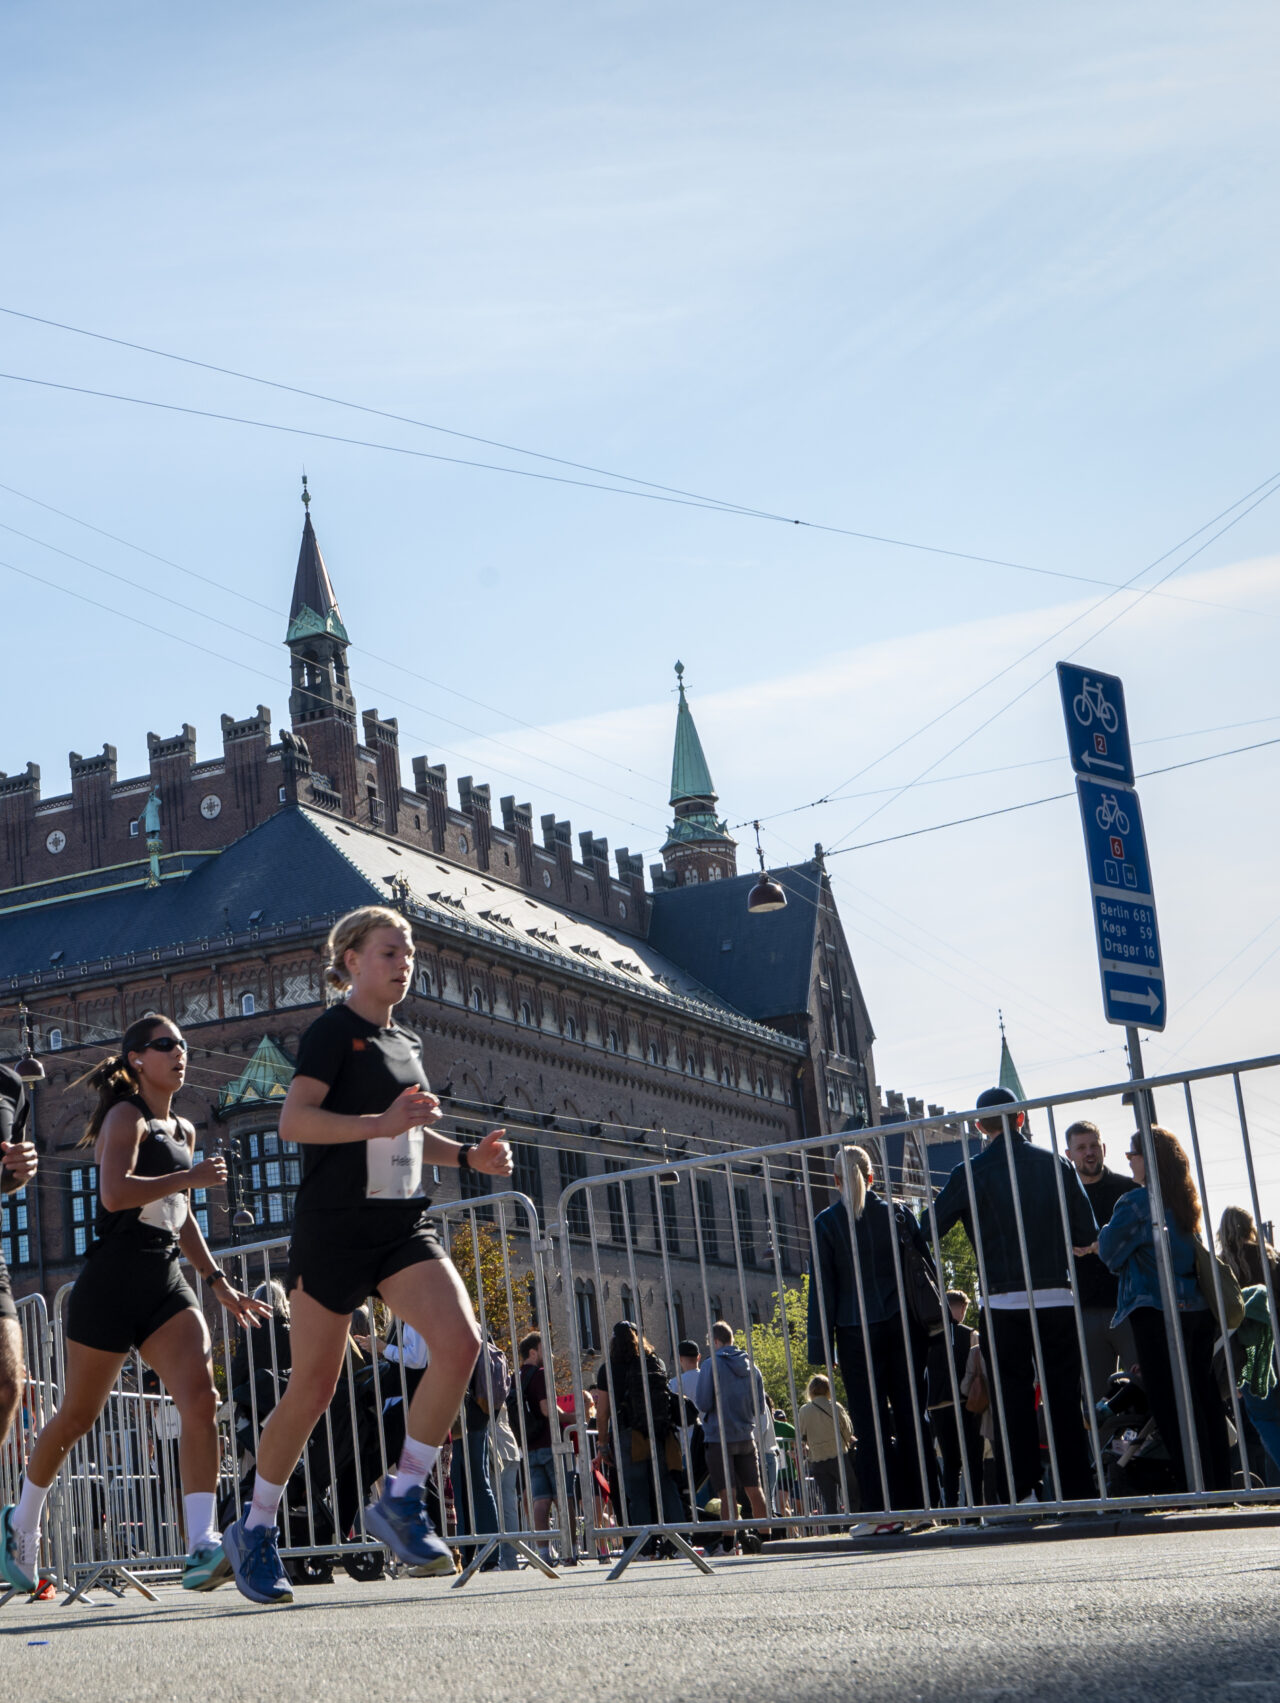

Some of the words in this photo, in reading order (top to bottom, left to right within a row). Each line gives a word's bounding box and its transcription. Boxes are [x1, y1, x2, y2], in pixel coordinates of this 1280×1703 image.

[1096, 737, 1104, 751] 2
[1114, 841, 1121, 855] 6
[1100, 902, 1129, 919] Berlin
[1133, 908, 1151, 923] 681
[1102, 919, 1127, 937] Køge
[1140, 926, 1153, 940] 59
[1104, 937, 1140, 957] Dragør
[1143, 945, 1155, 959] 16
